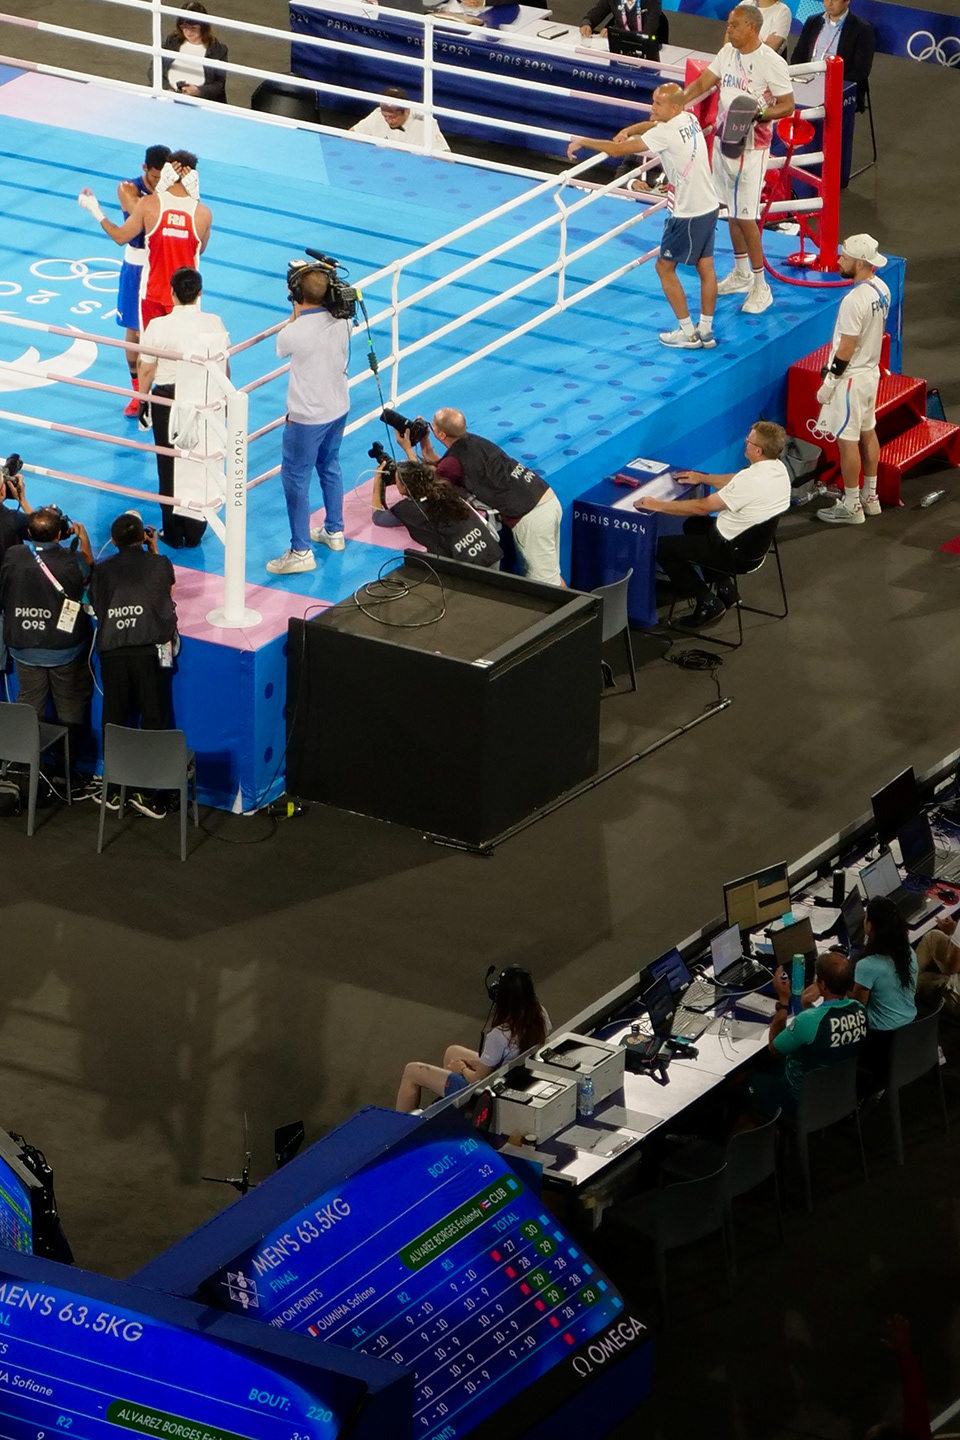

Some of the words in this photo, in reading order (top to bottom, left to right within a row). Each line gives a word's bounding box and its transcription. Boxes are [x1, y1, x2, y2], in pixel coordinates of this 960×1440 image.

[361, 26, 390, 40] 2024
[441, 43, 471, 56] 2024
[524, 59, 553, 73] 2024
[607, 76, 637, 90] 2024
[167, 213, 186, 226] FRA
[234, 430, 244, 465] 2024
[454, 527, 483, 552] PHOTO
[613, 519, 646, 535] 2024
[467, 540, 487, 557] 096
[14, 607, 52, 619] PHOTO
[107, 605, 144, 619] PHOTO
[116, 618, 137, 630] 097
[21, 620, 46, 631] 095
[830, 1025, 867, 1048] 2024
[427, 1155, 458, 1179] BOUT:
[460, 1138, 479, 1156] 220
[478, 1164, 494, 1178] 3:2
[251, 1233, 300, 1277] MEN'S
[296, 1198, 351, 1244] 63.5KG
[409, 1239, 437, 1264] ALVAREZ
[434, 1222, 459, 1248] BORGES
[489, 1187, 508, 1204] CUB
[269, 1270, 299, 1294] FINAL
[351, 1325, 366, 1338] R1
[397, 1291, 411, 1305] R2
[441, 1258, 455, 1272] R3
[493, 1213, 520, 1234] TOTAL
[376, 1335, 389, 1348] 10
[406, 1316, 414, 1325] 9
[421, 1301, 434, 1315] 10
[450, 1282, 458, 1292] 9
[465, 1269, 478, 1282] 10
[503, 1239, 516, 1253] 27
[525, 1224, 538, 1237] 30
[282, 1305, 297, 1322] ON
[296, 1288, 324, 1314] POINTS
[316, 1303, 351, 1331] OUMIHA
[348, 1286, 376, 1309] Sofiane
[391, 1351, 404, 1364] 10
[420, 1332, 429, 1342] 9
[436, 1318, 449, 1331] 10
[464, 1298, 476, 1311] 10
[480, 1287, 489, 1297] 9
[518, 1256, 531, 1270] 28
[540, 1240, 552, 1253] 29
[434, 1347, 447, 1361] 10
[452, 1336, 461, 1346] 9
[478, 1314, 491, 1327] 10
[495, 1303, 504, 1313] 9
[533, 1273, 545, 1286] 29
[554, 1257, 567, 1270] 28
[58, 1303, 143, 1342] 63.5KG
[421, 1386, 434, 1399] 10
[449, 1364, 462, 1377] 10
[467, 1353, 476, 1363] 9
[493, 1331, 505, 1344] 10
[510, 1320, 519, 1330] 9
[547, 1289, 560, 1303] 29
[569, 1273, 582, 1287] 28
[588, 1316, 647, 1364] OMEGA
[420, 1417, 429, 1426] 9
[436, 1402, 449, 1416] 10
[464, 1381, 476, 1394] 10
[481, 1370, 490, 1380] 9
[508, 1349, 518, 1359] 9
[524, 1335, 536, 1349] 10
[562, 1306, 575, 1319] 28
[583, 1290, 596, 1303] 29
[11, 1375, 54, 1397] Sofiane
[248, 1388, 291, 1412] BOUT:
[305, 1405, 333, 1423] 220
[56, 1415, 73, 1430] R2
[117, 1408, 161, 1431] ALVAREZ
[161, 1420, 201, 1440] BORGES
